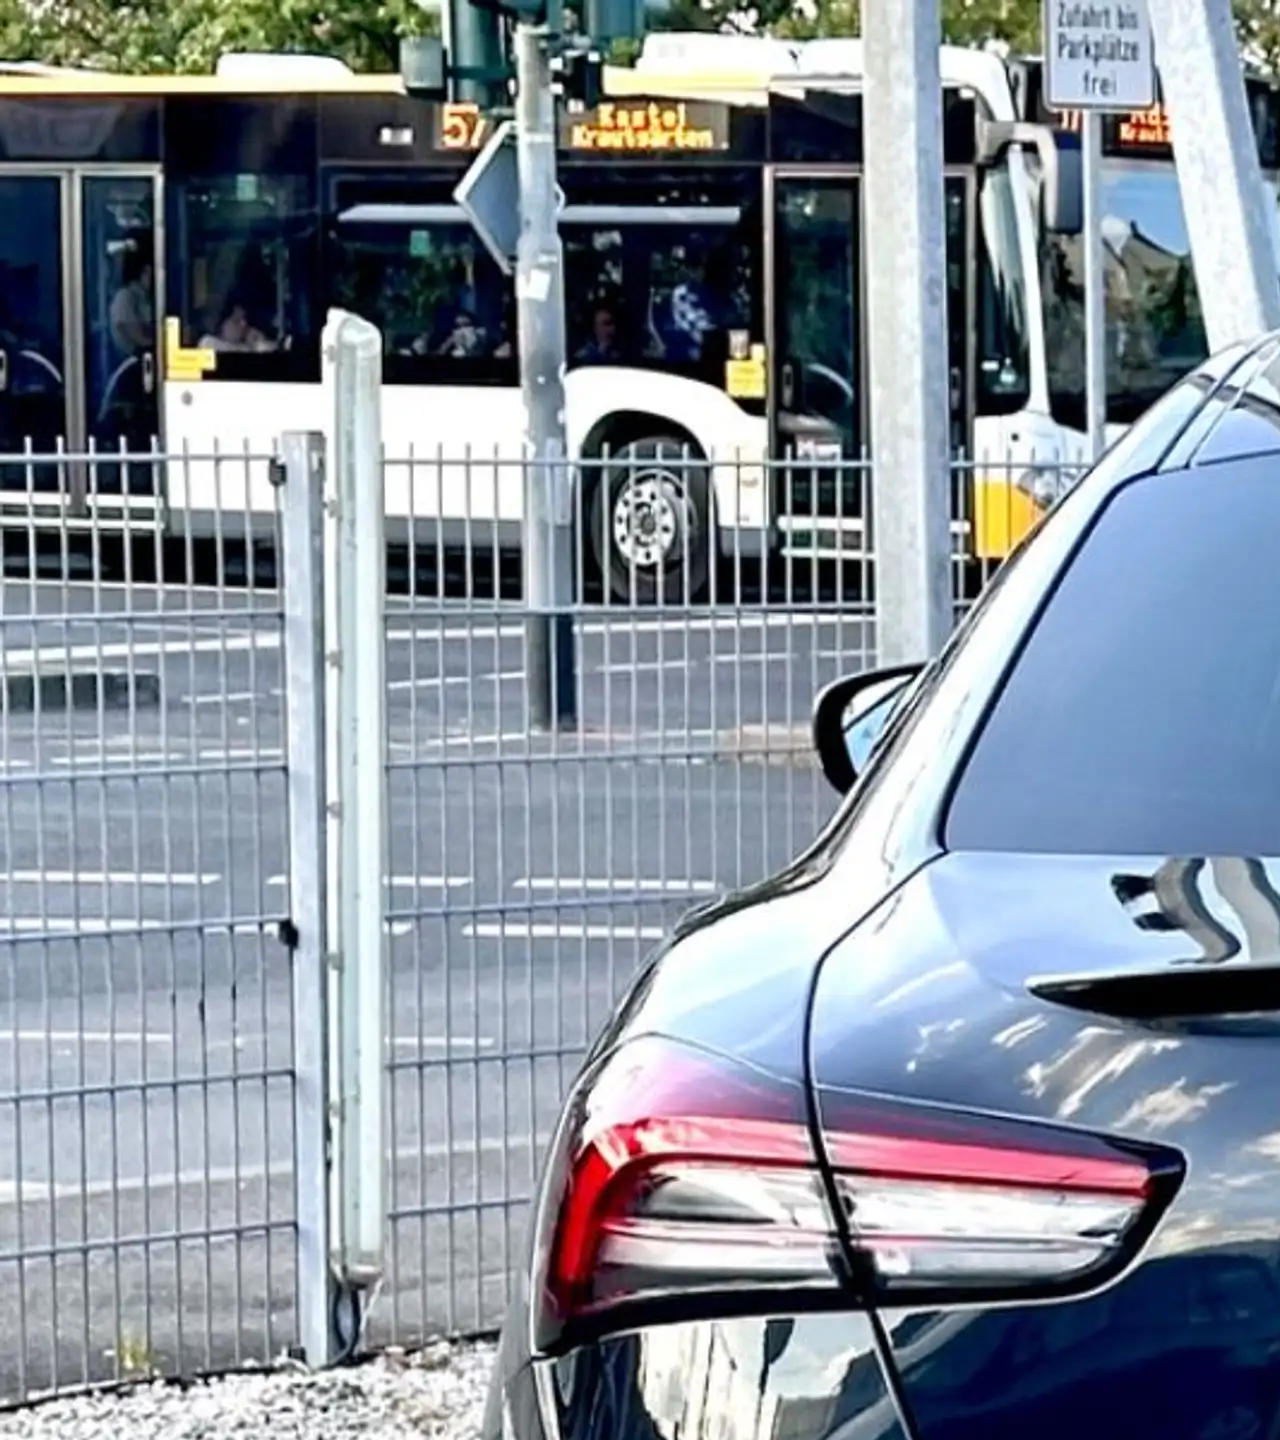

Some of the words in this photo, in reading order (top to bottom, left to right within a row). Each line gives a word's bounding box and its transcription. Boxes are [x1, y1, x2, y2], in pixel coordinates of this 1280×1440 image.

[1058, 2, 1111, 29] Zufahrt
[1117, 3, 1139, 30] bis
[1057, 32, 1139, 67] Parkplätze
[1083, 69, 1118, 97] frei
